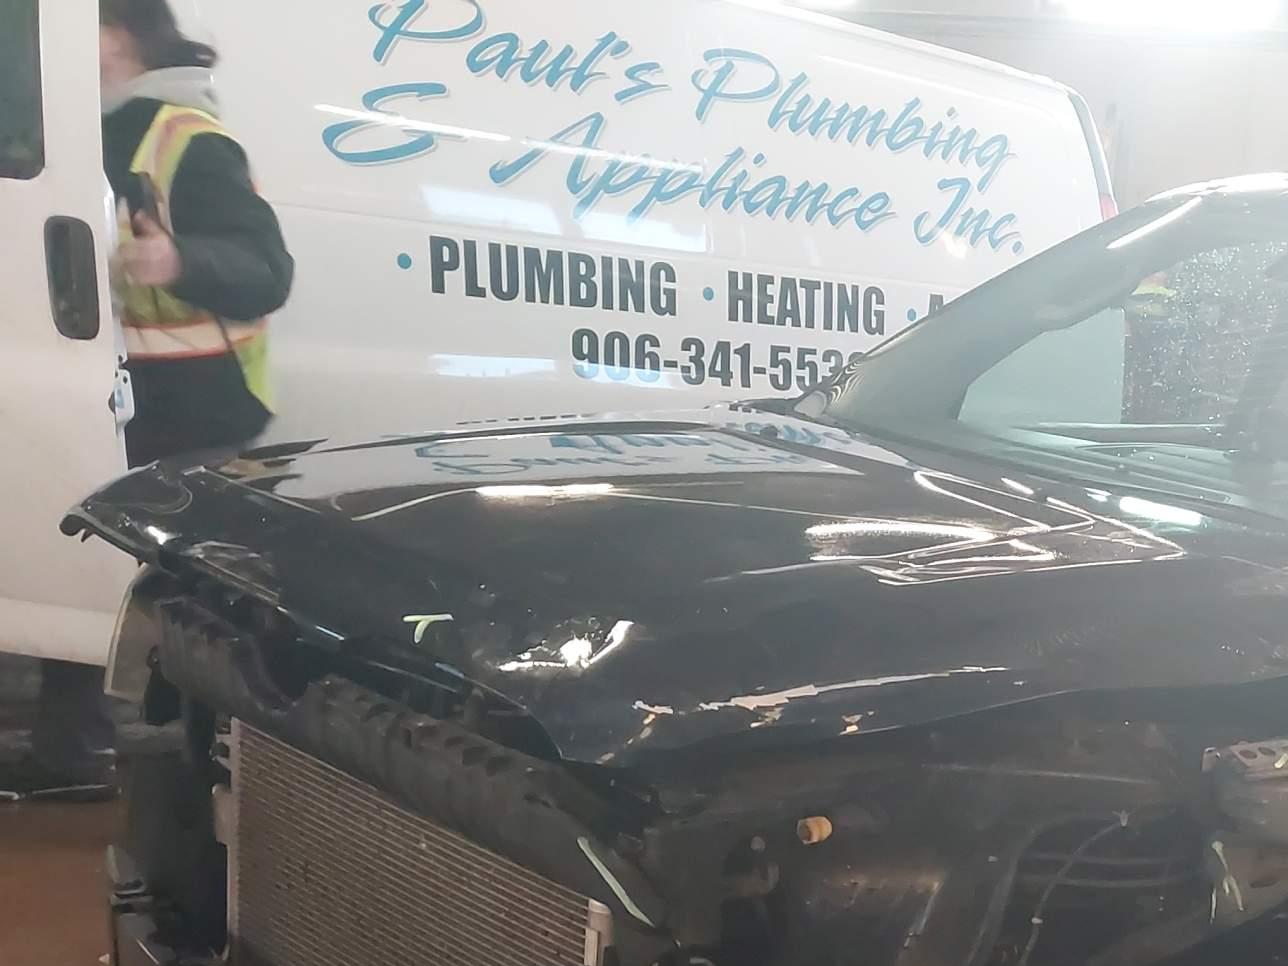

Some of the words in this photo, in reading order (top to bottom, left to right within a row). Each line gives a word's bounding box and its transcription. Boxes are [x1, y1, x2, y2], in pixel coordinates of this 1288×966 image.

[368, 0, 668, 102] Paul's
[691, 47, 1017, 193] Plumbing
[489, 111, 897, 231] Appliance
[913, 177, 1024, 255] Inc.
[429, 235, 677, 317] PLUMBING
[728, 270, 885, 336] HEATING
